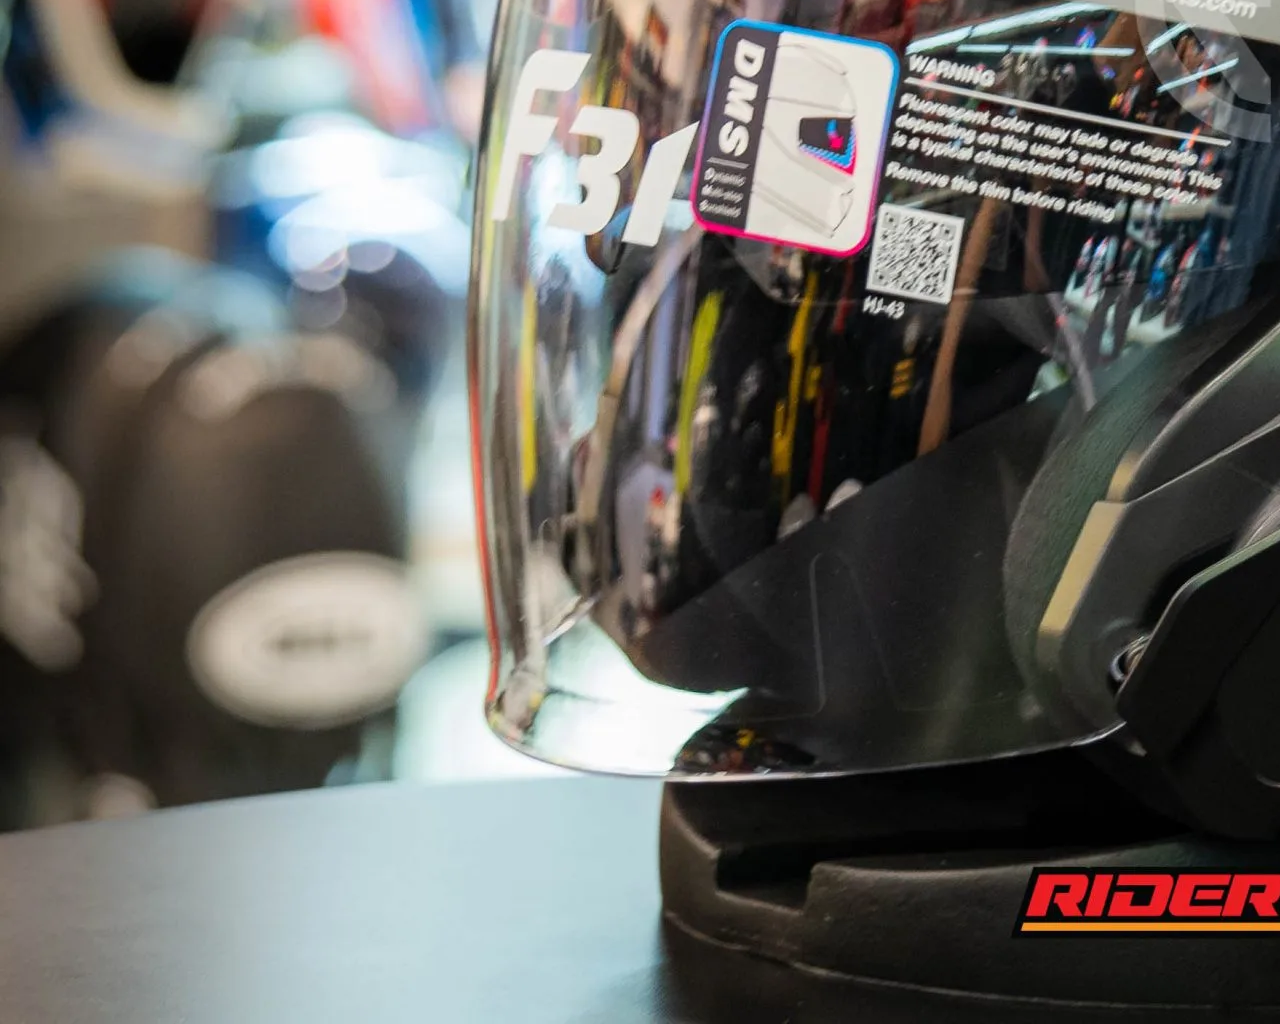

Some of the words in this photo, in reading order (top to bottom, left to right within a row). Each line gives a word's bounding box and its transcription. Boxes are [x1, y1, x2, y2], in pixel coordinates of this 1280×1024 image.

[718, 38, 766, 157] DMS
[909, 54, 996, 87] WARNING
[895, 113, 977, 145] depending
[977, 132, 1000, 147] on
[1001, 134, 1029, 153] the
[1029, 142, 1080, 163] user's
[1187, 169, 1223, 190] This
[907, 136, 920, 151] a
[920, 137, 975, 161] typical
[1085, 172, 1106, 187] of
[1105, 175, 1152, 197] these
[991, 115, 1035, 134] color
[1033, 123, 1071, 144] may
[1070, 128, 1109, 149] fade
[1109, 139, 1131, 153] or
[1130, 141, 1199, 167] degrade
[885, 161, 950, 188] Remove
[978, 180, 1012, 200] film
[1011, 186, 1067, 211] before
